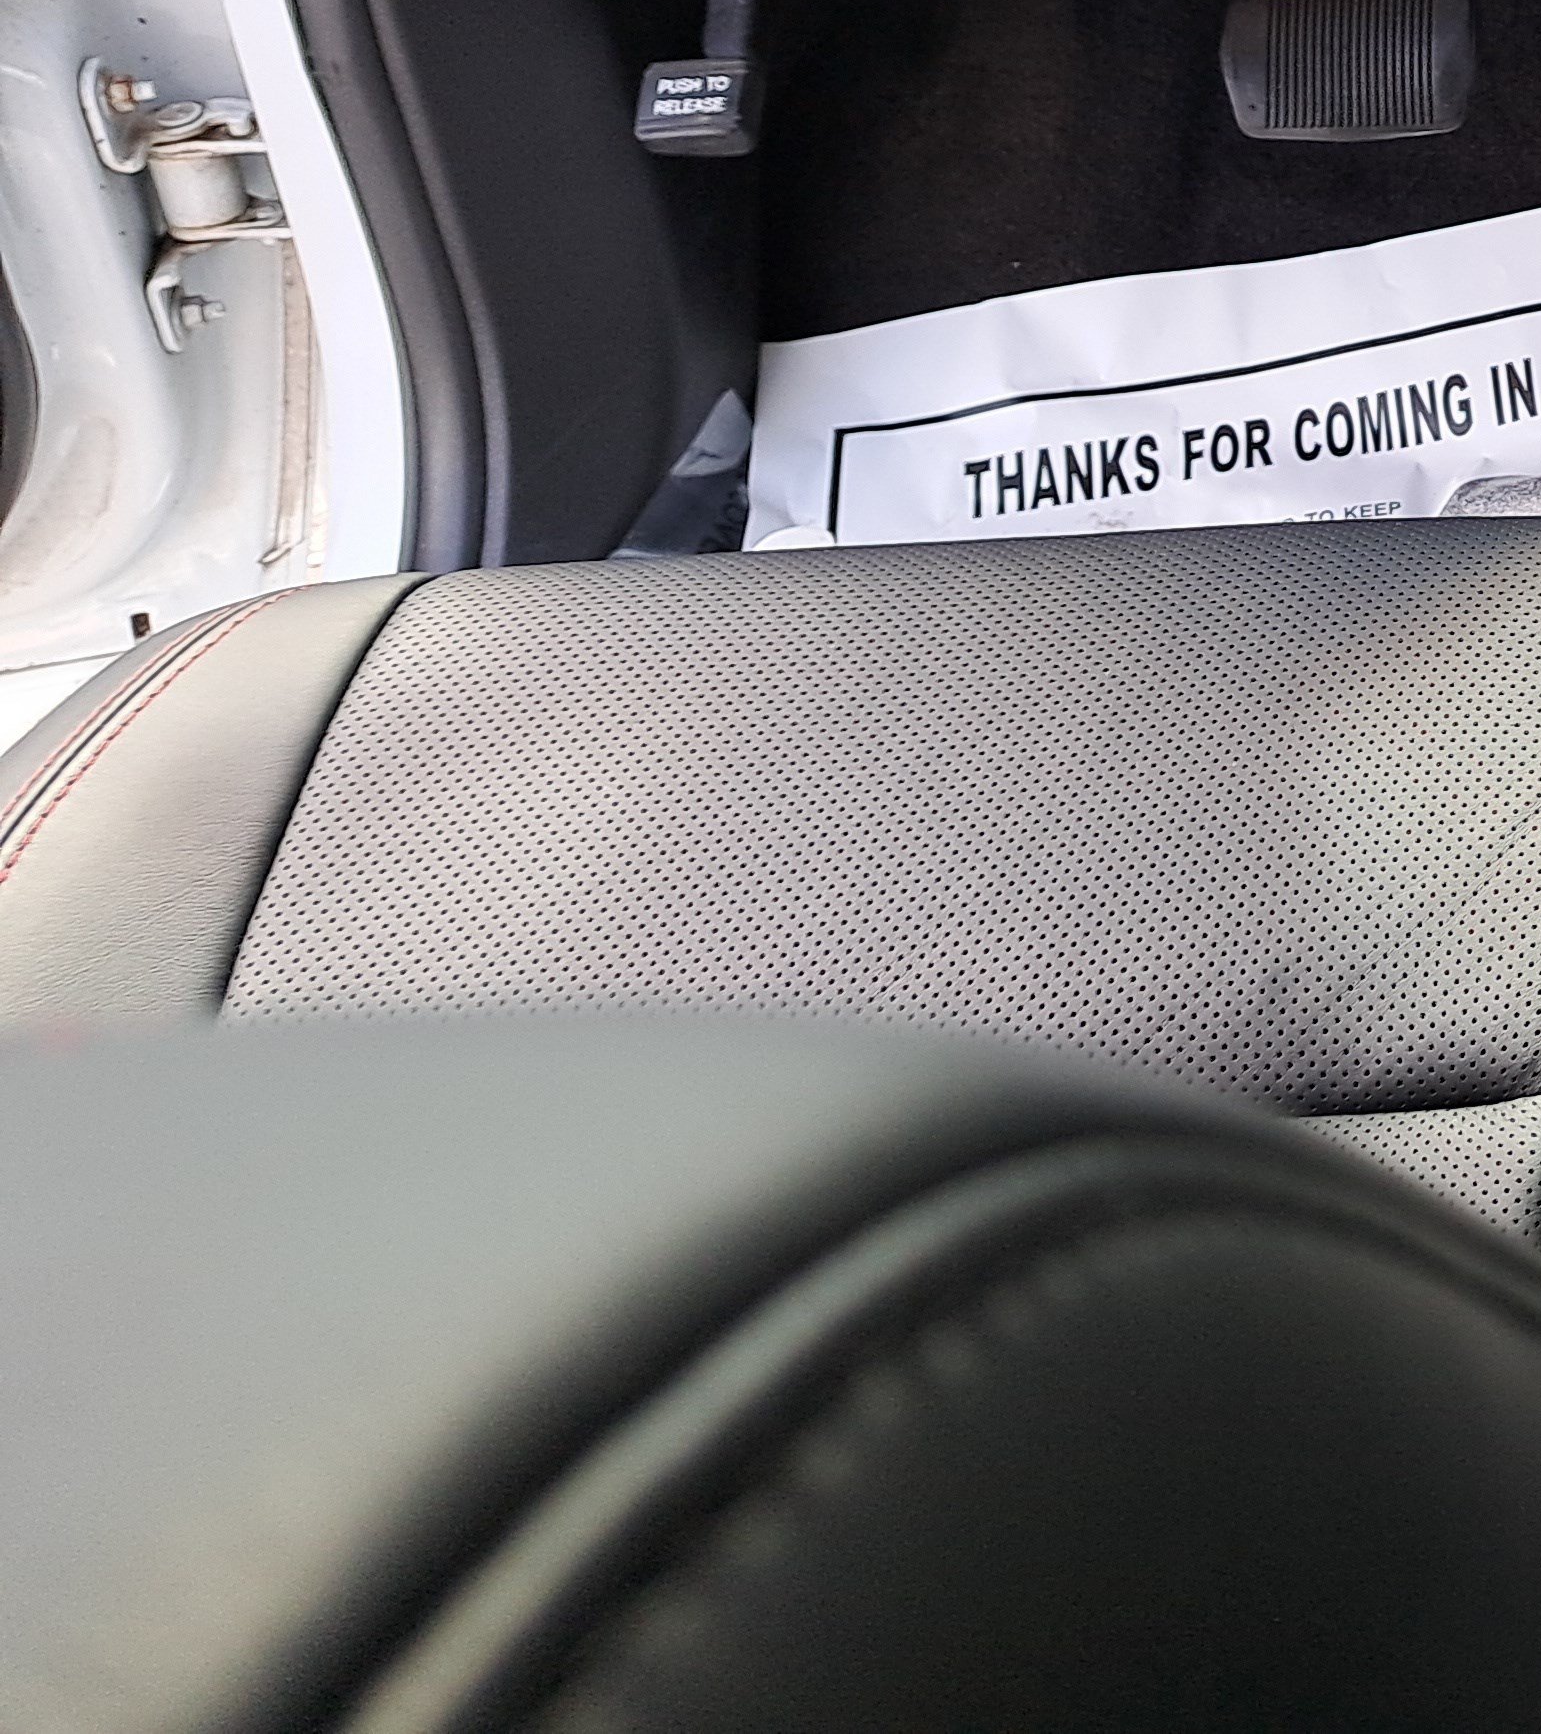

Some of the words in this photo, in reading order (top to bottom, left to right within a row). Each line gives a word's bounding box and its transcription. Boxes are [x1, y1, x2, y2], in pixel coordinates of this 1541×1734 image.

[656, 77, 703, 95] PUSH
[705, 75, 732, 92] TO
[653, 96, 729, 116] RELEASE
[963, 432, 1160, 518] THANKS
[1181, 417, 1273, 480] FOR
[1294, 373, 1472, 462] COMING
[1490, 357, 1539, 426] IN
[1344, 501, 1401, 519] KEEP
